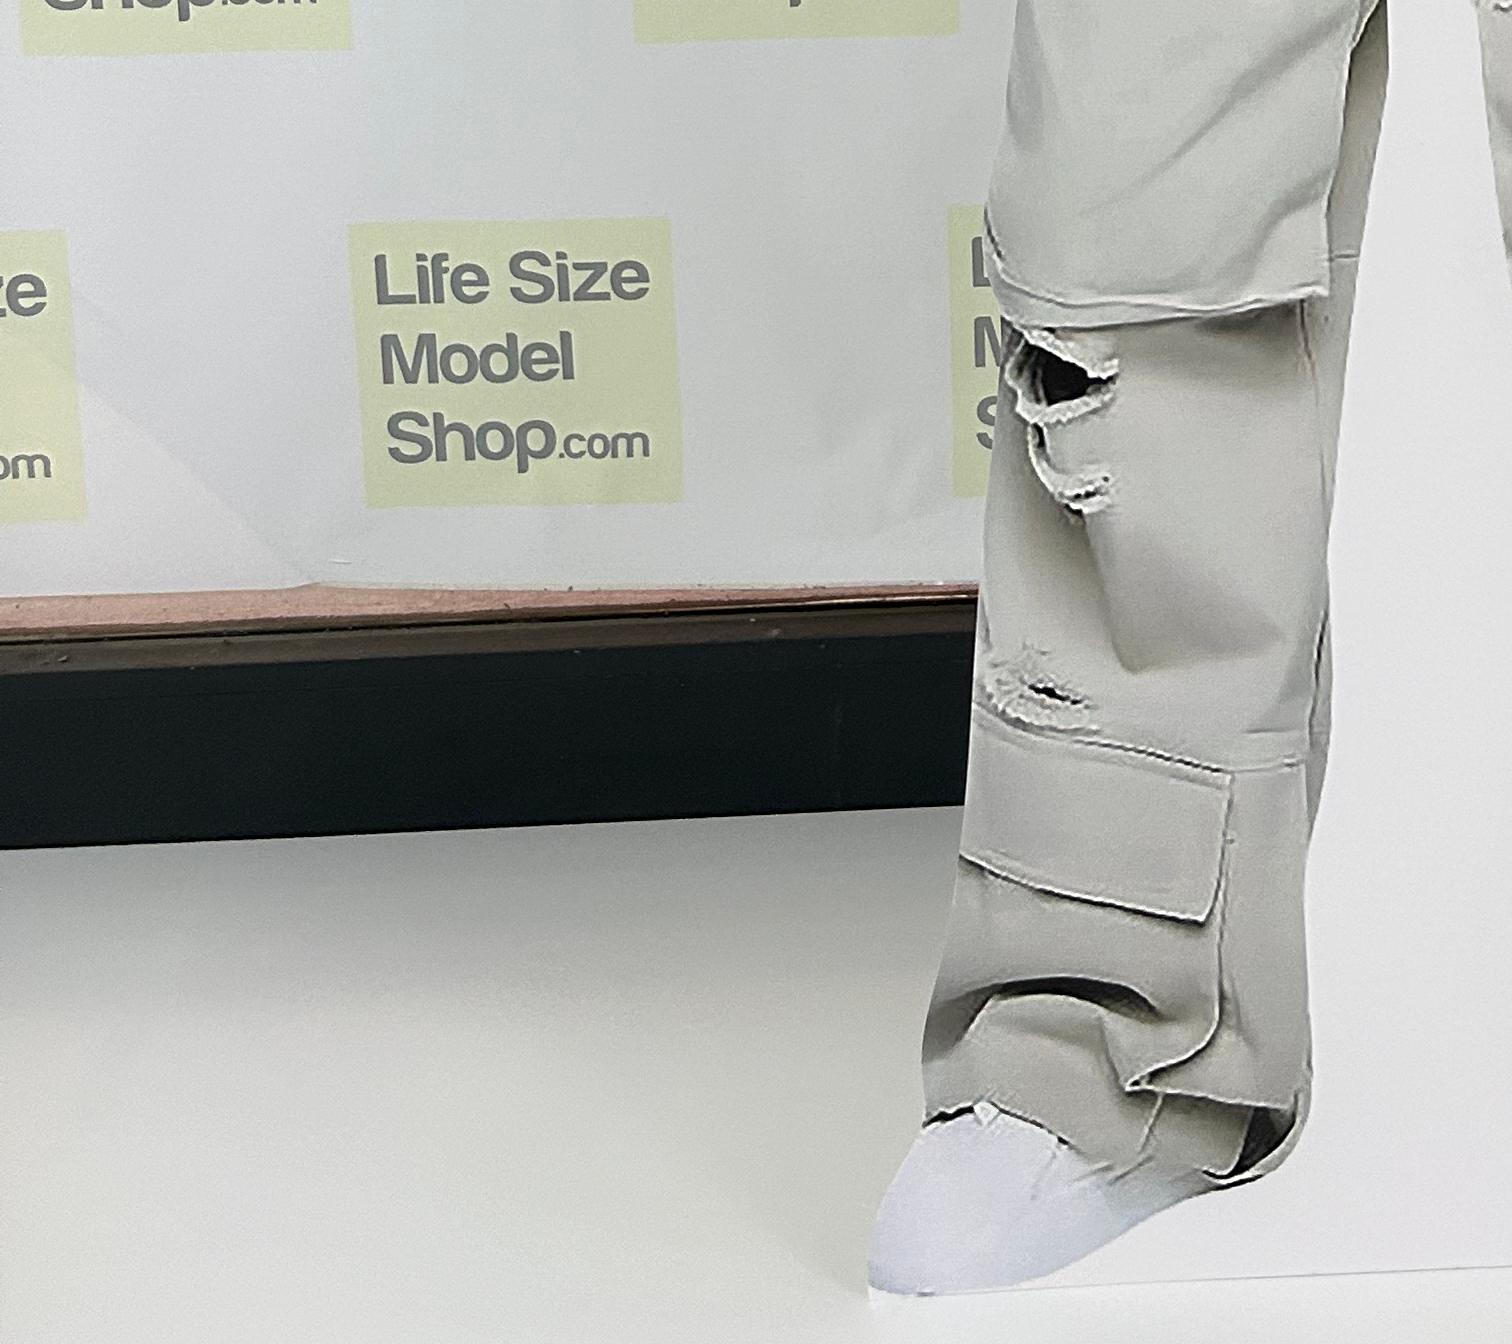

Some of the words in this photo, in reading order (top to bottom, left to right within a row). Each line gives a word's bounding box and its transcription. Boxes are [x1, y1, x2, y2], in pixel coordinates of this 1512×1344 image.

[375, 253, 490, 305] Life
[509, 251, 650, 304] Size
[381, 331, 574, 384] Model
[387, 411, 649, 473] Shop.com
